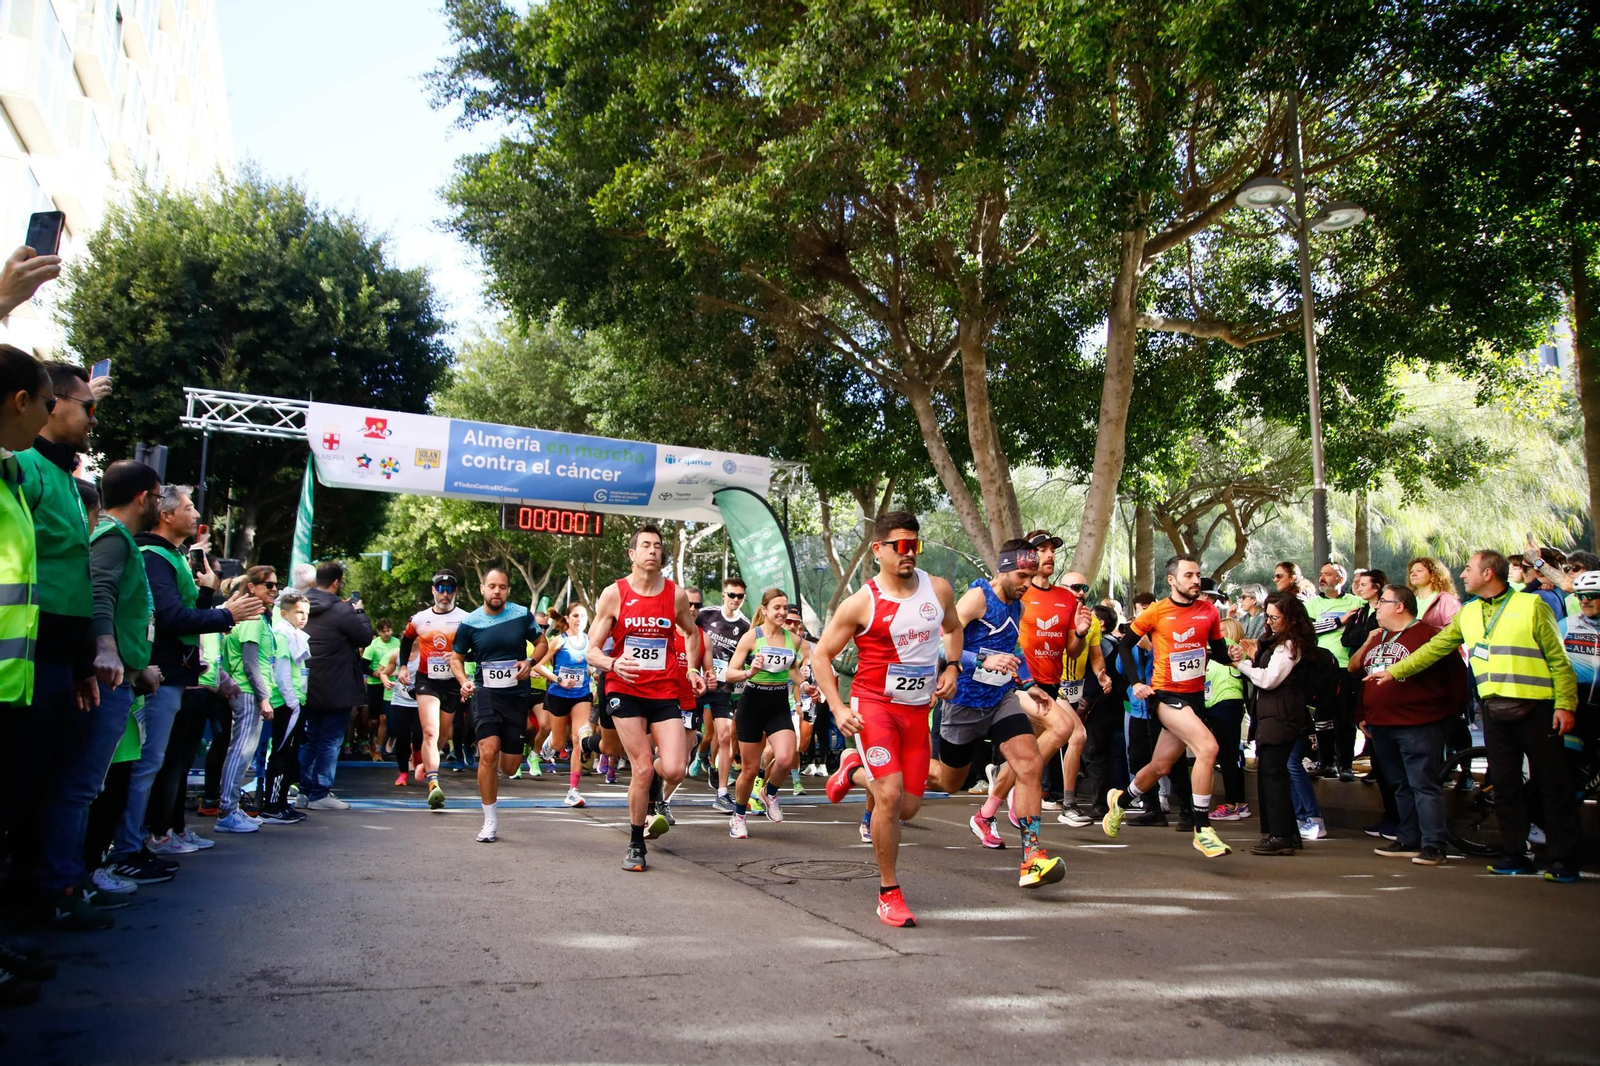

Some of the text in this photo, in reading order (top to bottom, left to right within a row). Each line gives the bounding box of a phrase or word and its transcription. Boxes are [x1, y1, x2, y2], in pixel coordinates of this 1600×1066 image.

[463, 429, 646, 464] Almería en marcha
[461, 454, 622, 483] contra el cáncer
[898, 628, 931, 647] ALM
[1036, 629, 1064, 639] Europack
[1574, 633, 1597, 642] BIKES
[1173, 641, 1202, 650] Europack
[632, 647, 659, 660] 285
[766, 654, 787, 665] 731
[1178, 658, 1201, 672] 543
[432, 664, 451, 673] 637
[489, 669, 512, 680] 504
[895, 676, 926, 691] 225
[1063, 686, 1079, 696] 398
